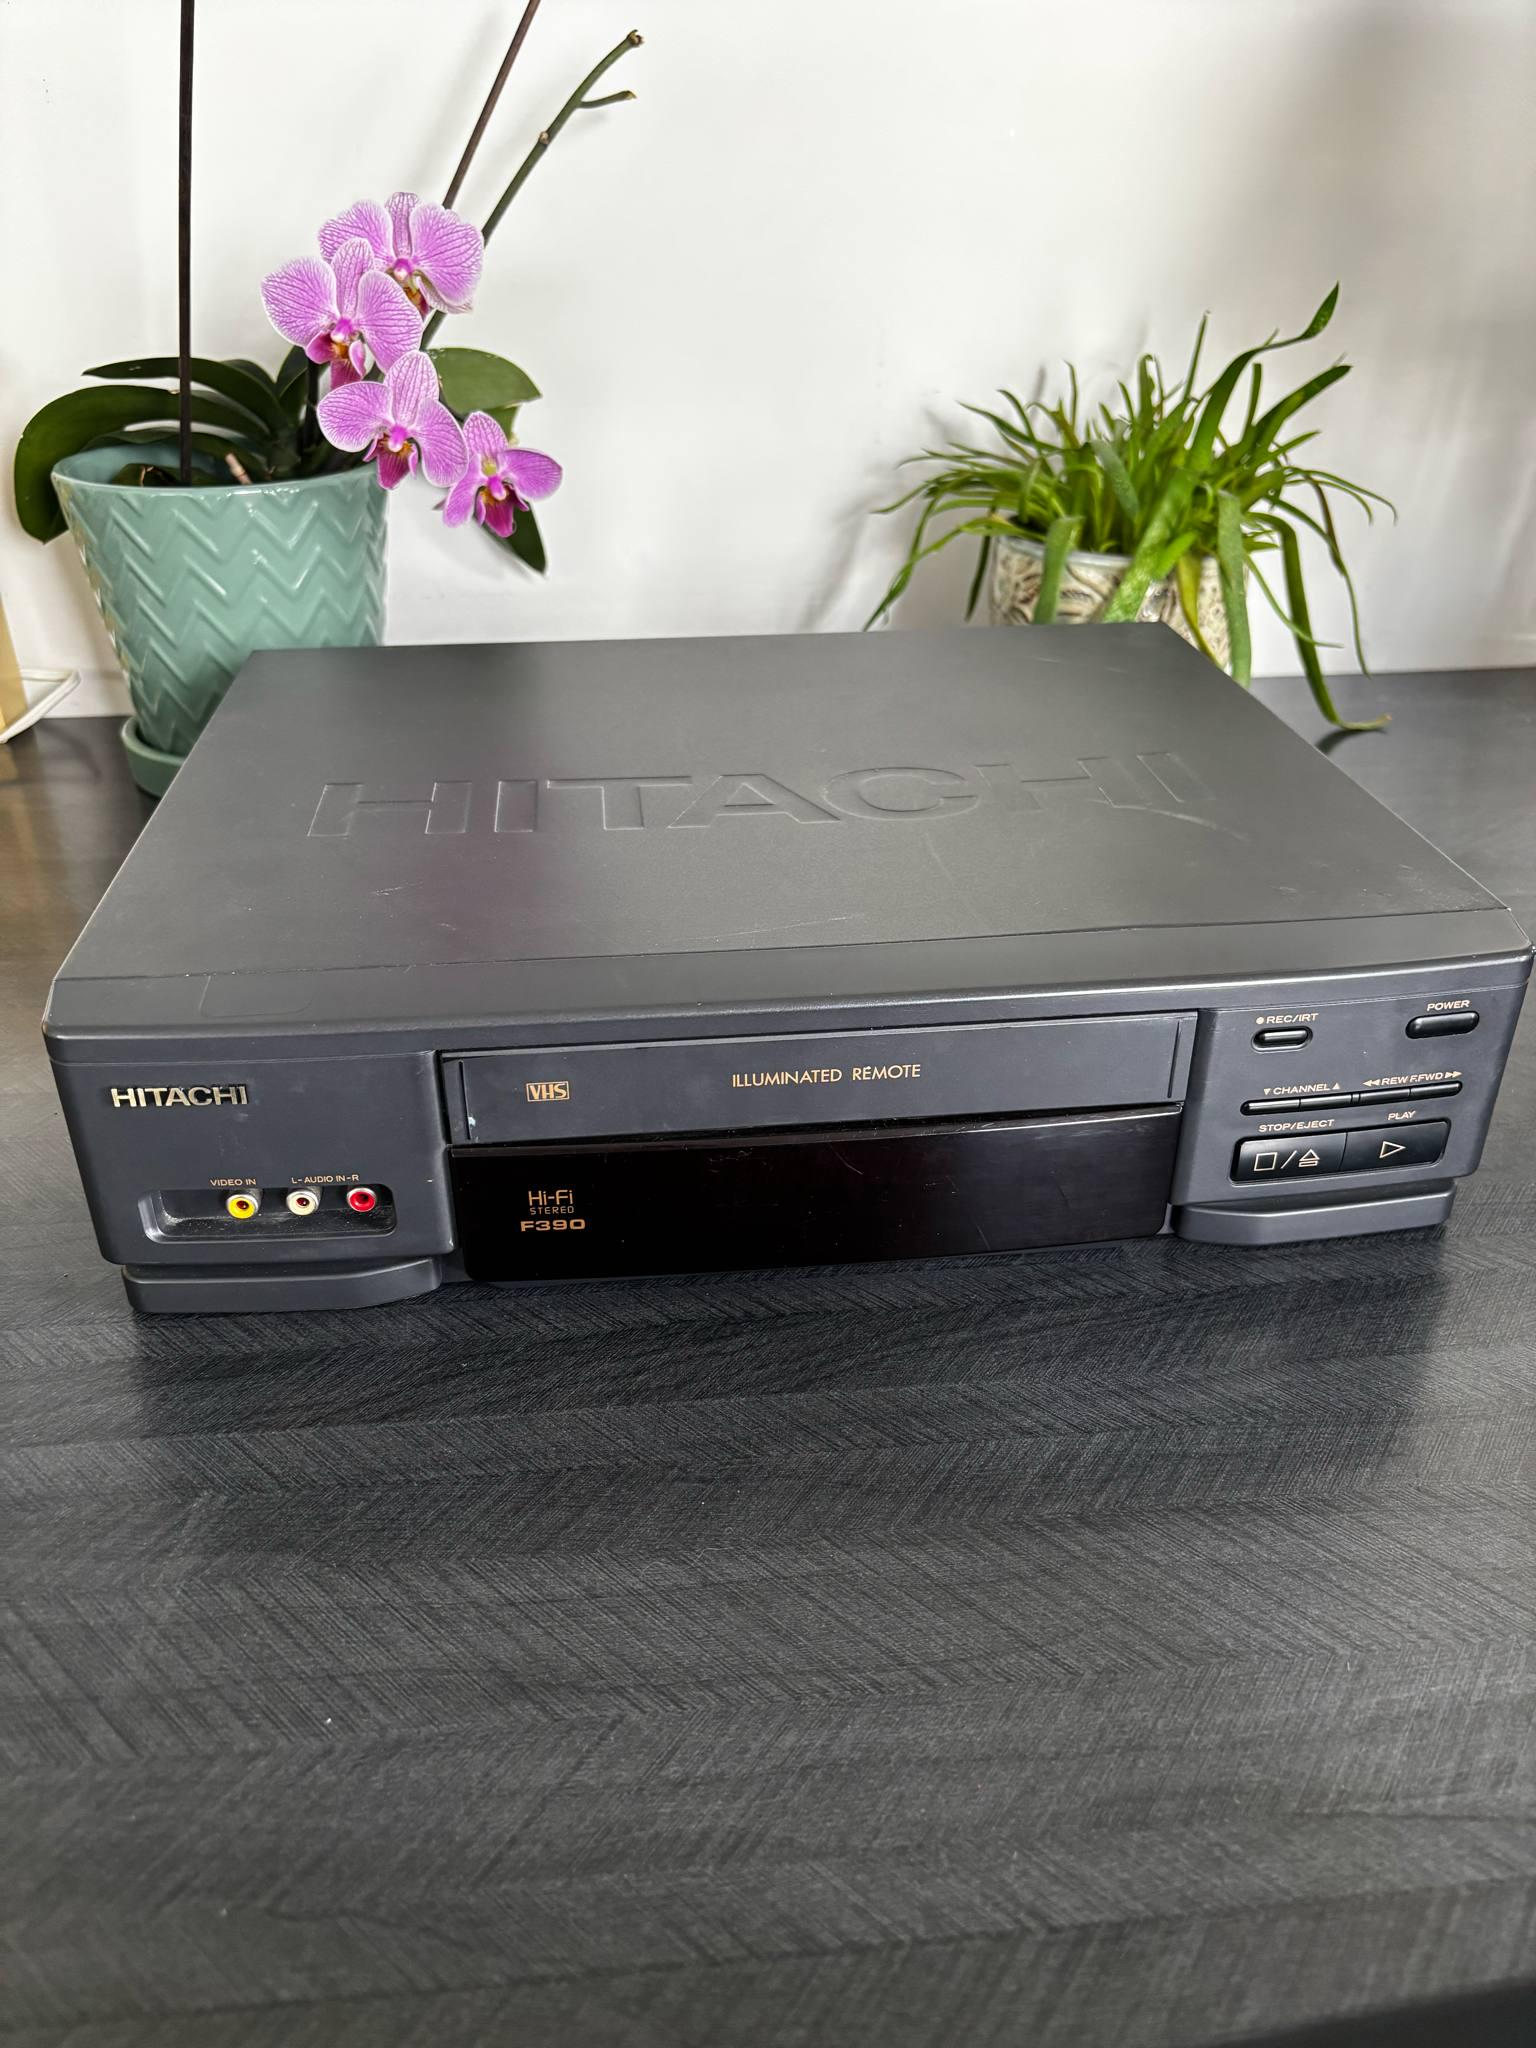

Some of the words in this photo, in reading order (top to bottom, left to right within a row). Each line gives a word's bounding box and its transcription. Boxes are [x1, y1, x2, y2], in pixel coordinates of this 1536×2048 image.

[306, 751, 1216, 837] HITACHI
[1427, 1000, 1470, 1011] POWER
[1266, 1012, 1319, 1024] REC/IRT
[732, 1069, 842, 1088] ILLUMINATED
[852, 1064, 921, 1083] REMOTE
[1381, 1075, 1408, 1086] REW
[528, 1082, 569, 1100] VHS
[1273, 1083, 1331, 1095] CHANNEL
[110, 1085, 248, 1108] HITACHI
[1388, 1110, 1416, 1120] PLAY
[1258, 1119, 1335, 1132] STOP/EJECT
[210, 1179, 243, 1187] VIDEO
[245, 1178, 257, 1186] IN
[528, 1189, 574, 1206] Hi-Fi
[529, 1205, 575, 1216] STEREO
[520, 1218, 586, 1232] F390
